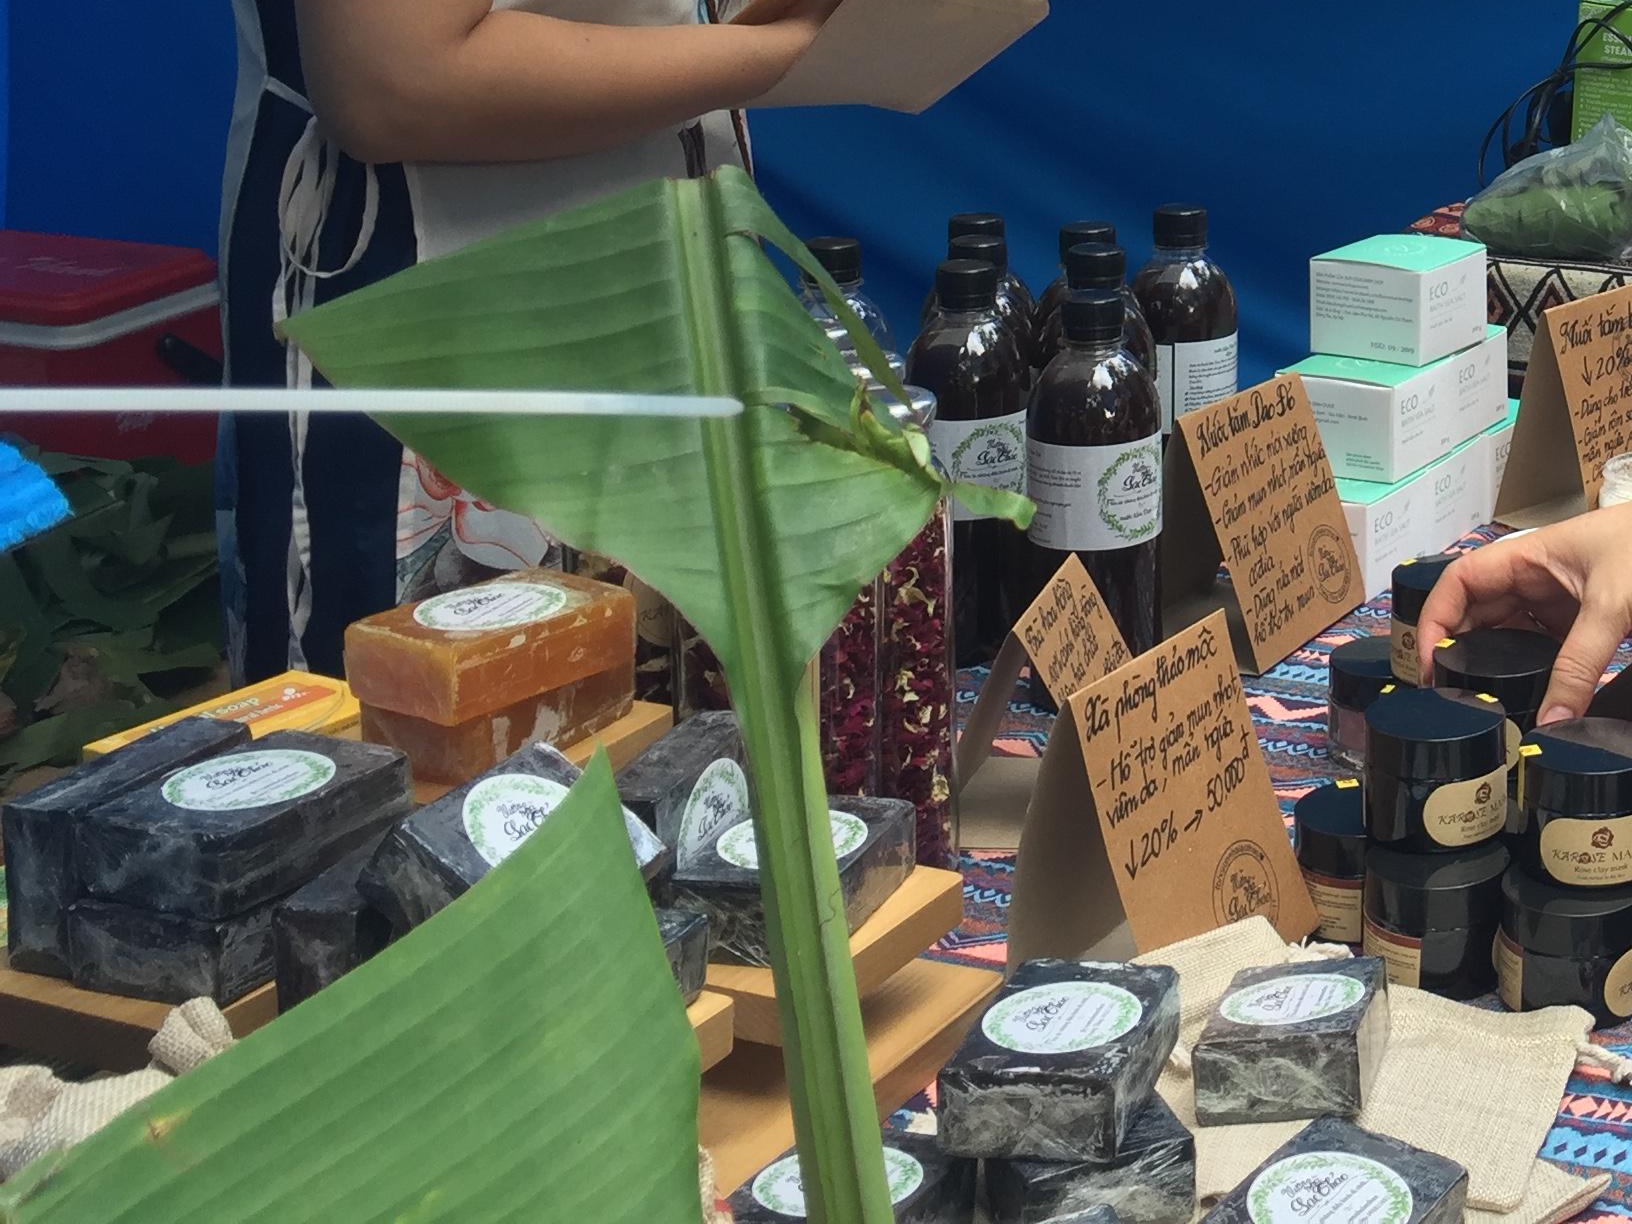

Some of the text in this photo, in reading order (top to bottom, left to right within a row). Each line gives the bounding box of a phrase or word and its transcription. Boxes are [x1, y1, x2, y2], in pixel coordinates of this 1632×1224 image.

[1430, 281, 1448, 301] ECO
[1459, 363, 1475, 383] ECO
[1401, 394, 1419, 415] ECO
[1435, 474, 1451, 496] ECO
[1374, 511, 1393, 533] ECO
[1085, 625, 1218, 744] Xà phòng thảo mộc
[216, 697, 260, 715] soap
[1159, 711, 1185, 771] giảm
[1105, 791, 1140, 829] viêm
[1172, 732, 1200, 777] mẩn
[1438, 806, 1488, 825] KAROSE
[1141, 810, 1178, 869] 20%
[1552, 848, 1606, 865] KAROSE
